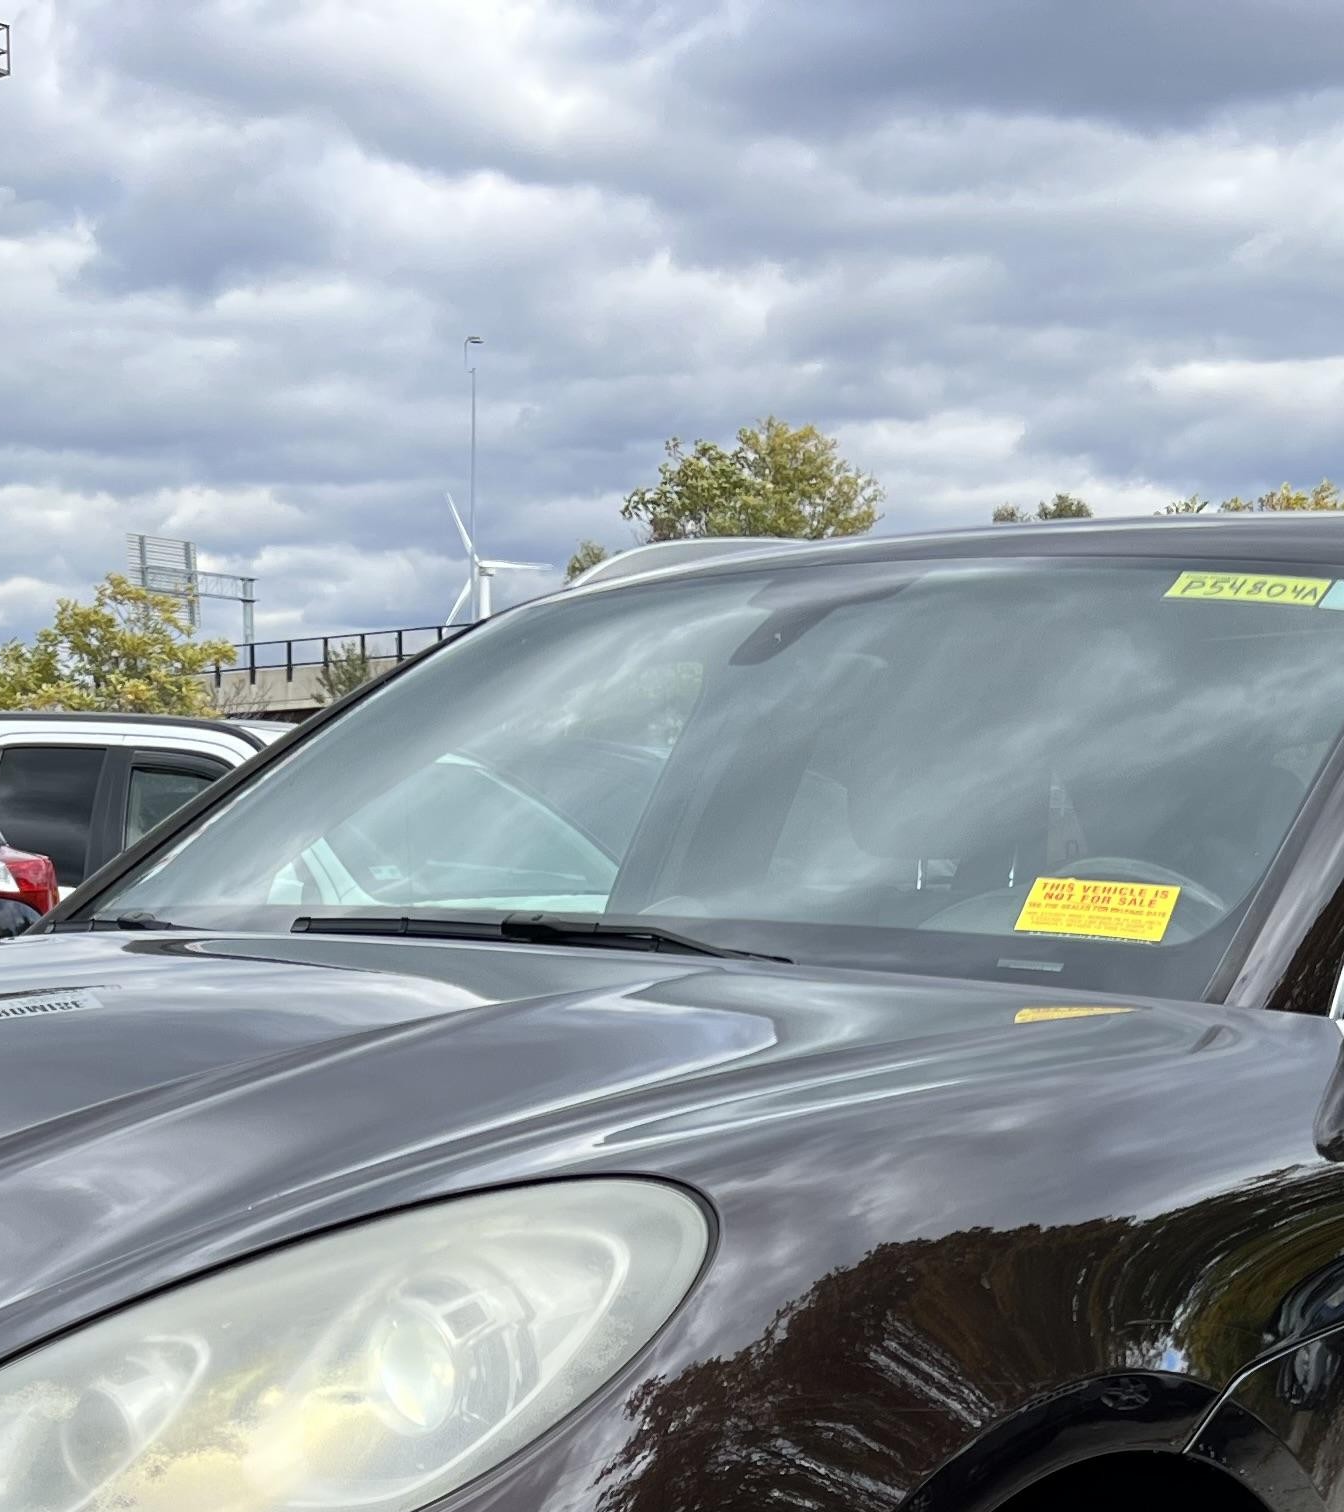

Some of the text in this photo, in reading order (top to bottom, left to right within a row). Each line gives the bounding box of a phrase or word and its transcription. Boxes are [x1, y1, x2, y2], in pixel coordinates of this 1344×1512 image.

[1180, 578, 1318, 600] P54804A
[1041, 882, 1170, 899] THIS VEHICLE IS
[1043, 892, 1158, 908] NOT FOR SALE
